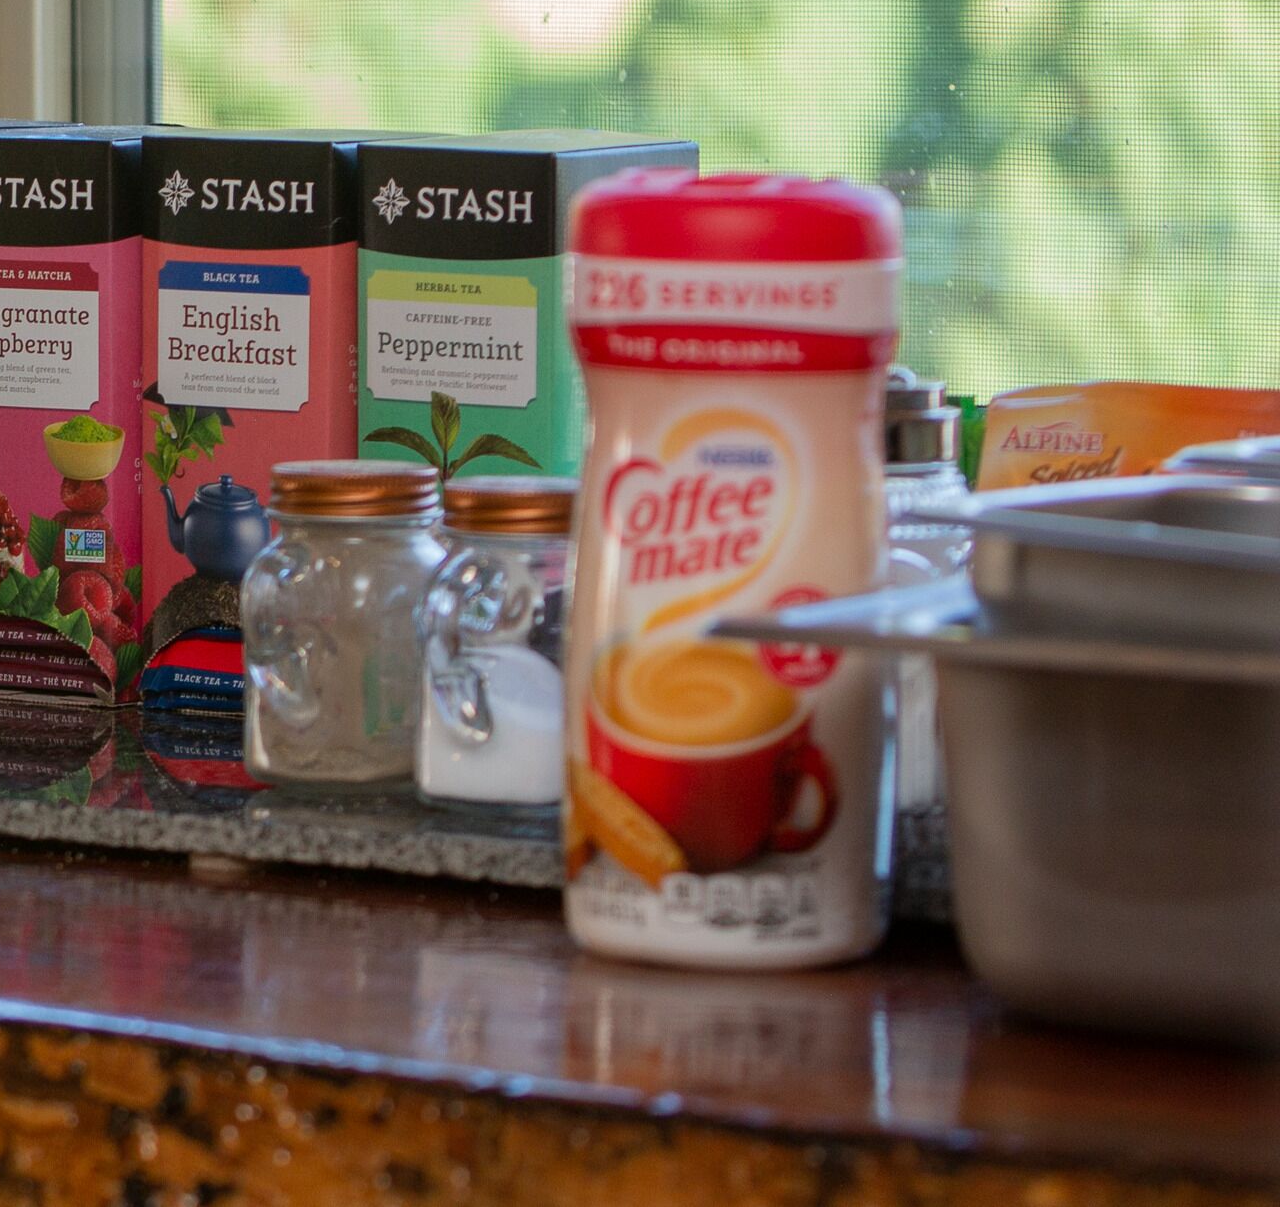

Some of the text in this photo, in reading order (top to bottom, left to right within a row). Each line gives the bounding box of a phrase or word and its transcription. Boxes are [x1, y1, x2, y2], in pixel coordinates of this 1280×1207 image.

[201, 178, 315, 214] STASH
[416, 187, 534, 224] STASH
[18, 270, 24, 279] &
[27, 270, 72, 281] MATCHA
[203, 272, 260, 284] BLACK TEA
[416, 282, 482, 294] HERBAL TEA
[659, 279, 837, 311] SERVINGS
[182, 304, 281, 336] English
[406, 313, 493, 327] CAFFEINE-FREE
[168, 336, 297, 367] Breakfast
[378, 331, 524, 362] Peppermint
[607, 333, 806, 366] THE ORIGINAL
[6, 363, 25, 372] blend
[27, 364, 34, 372] of
[35, 366, 56, 374] green
[421, 368, 436, 376] and
[226, 374, 246, 383] blend
[257, 376, 278, 384] black
[425, 379, 437, 387] the
[1001, 425, 1103, 453] ALPINE
[1031, 447, 1122, 484] Spiced
[602, 457, 774, 543] Coffee
[629, 528, 762, 585] mate
[8, 631, 24, 639] TEA
[20, 652, 36, 661] TEA
[16, 674, 32, 683] TEA
[61, 680, 84, 689] VERT
[174, 673, 200, 684] BLACK
[204, 677, 221, 686] TEA
[232, 679, 247, 688] TH
